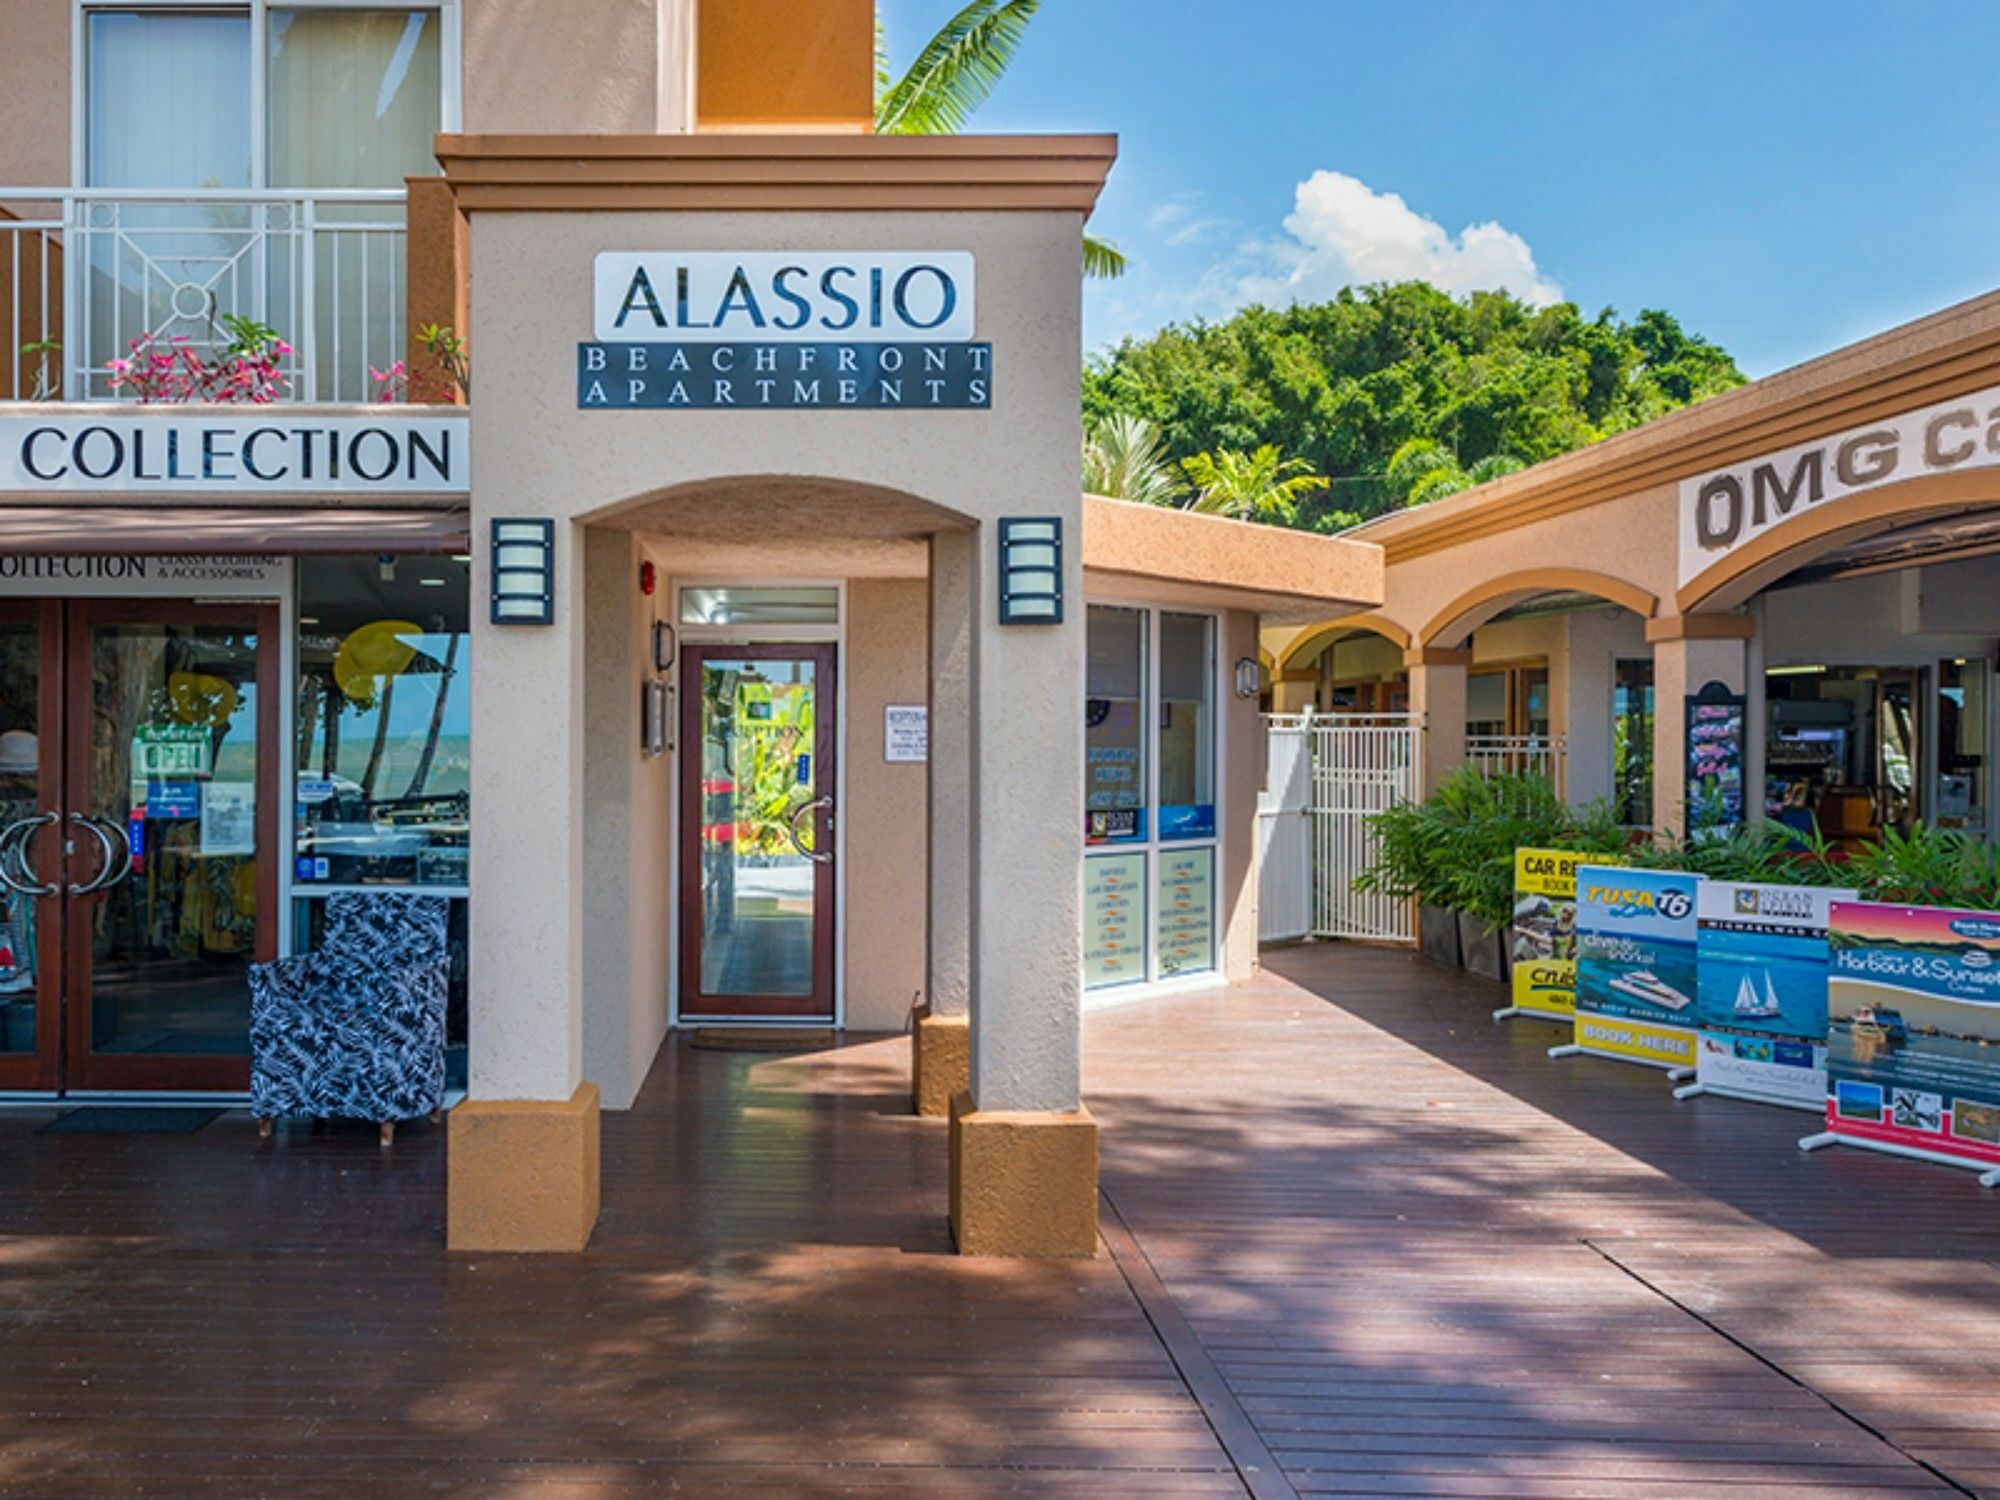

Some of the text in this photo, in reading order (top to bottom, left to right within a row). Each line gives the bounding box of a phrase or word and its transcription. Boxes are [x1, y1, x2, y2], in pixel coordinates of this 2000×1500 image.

[613, 265, 957, 329] ALASSIO
[586, 347, 988, 373] BEACHFRONT
[585, 379, 987, 404] APARTMENTS
[21, 427, 452, 482] COLLECTION
[1695, 429, 1900, 551] OMG
[146, 744, 202, 769] OPEN
[1524, 857, 1555, 876] CAR
[1542, 877, 1570, 891] BOOK
[1761, 889, 1813, 901] OCEAN
[1586, 886, 1655, 909] TUSA
[1836, 949, 1910, 975] Harbour
[1912, 957, 1930, 979] &
[1584, 1023, 1633, 1044] BOOK
[1638, 1034, 1690, 1056] HERE
